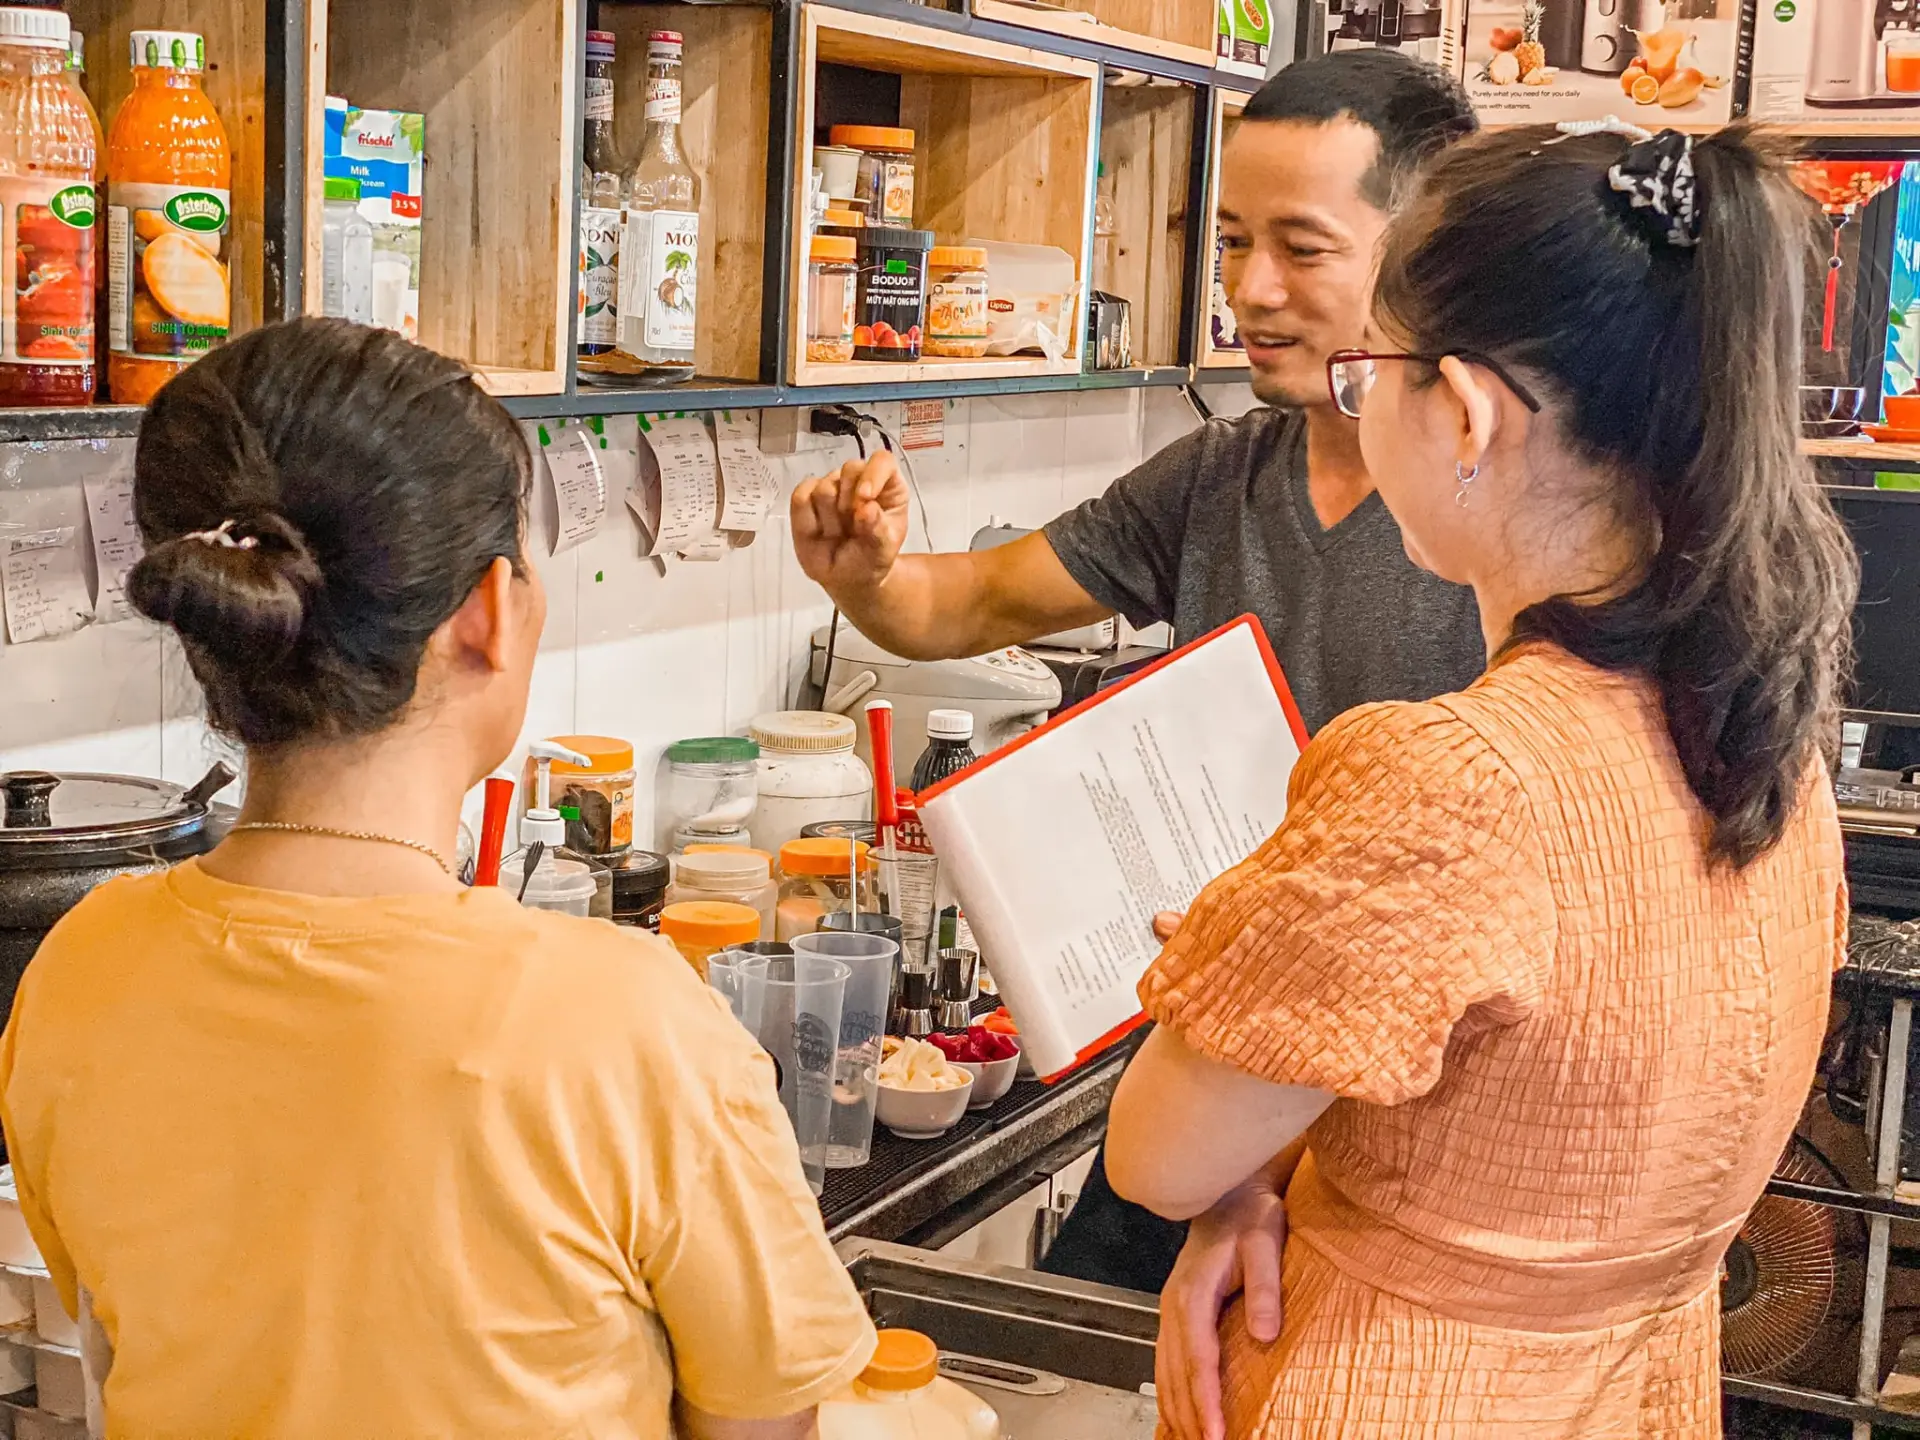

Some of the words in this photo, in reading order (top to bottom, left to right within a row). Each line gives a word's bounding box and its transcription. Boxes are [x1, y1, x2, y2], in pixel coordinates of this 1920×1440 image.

[1472, 90, 1492, 98] Purely
[1565, 90, 1581, 98] daily
[350, 165, 370, 176] Milk
[872, 275, 908, 286] BODUO
[989, 301, 1013, 311] Lipton
[151, 322, 177, 334] SINH
